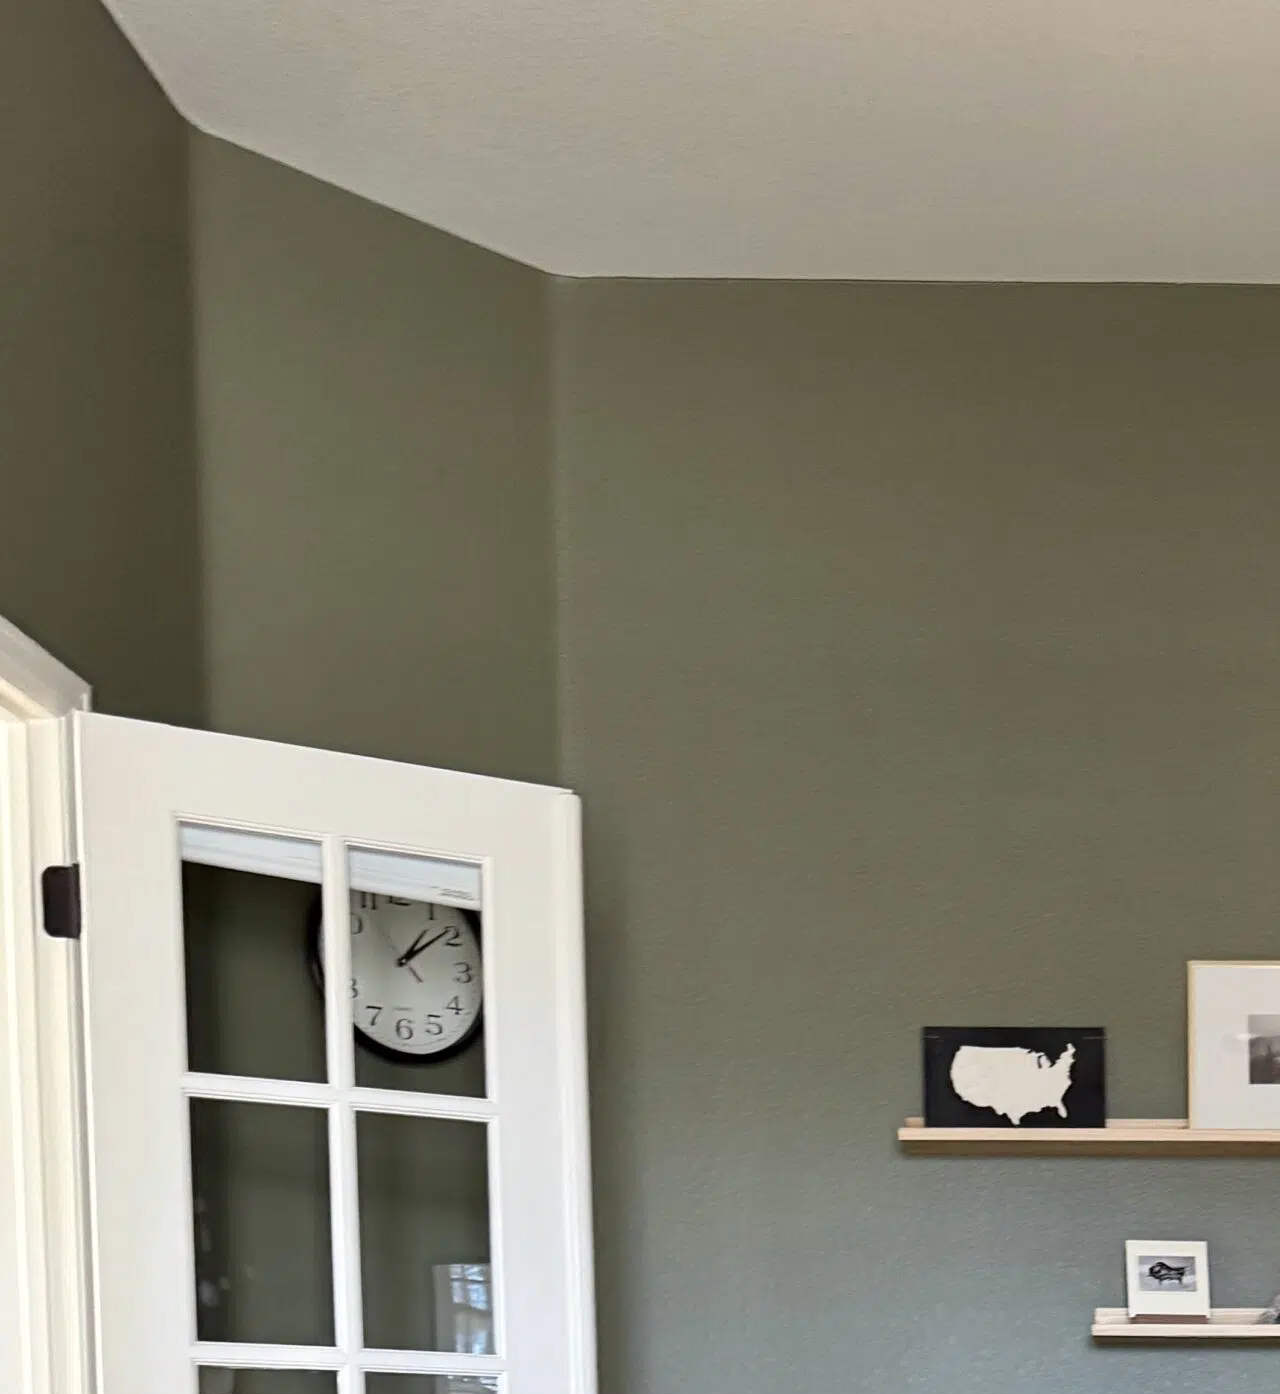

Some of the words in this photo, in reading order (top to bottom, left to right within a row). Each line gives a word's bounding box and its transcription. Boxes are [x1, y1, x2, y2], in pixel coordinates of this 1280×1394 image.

[444, 925, 462, 947] 2
[453, 962, 472, 984] 3
[365, 1005, 383, 1026] 7
[445, 995, 464, 1015] 4
[395, 1018, 414, 1040] 6
[424, 1014, 443, 1036] 5
